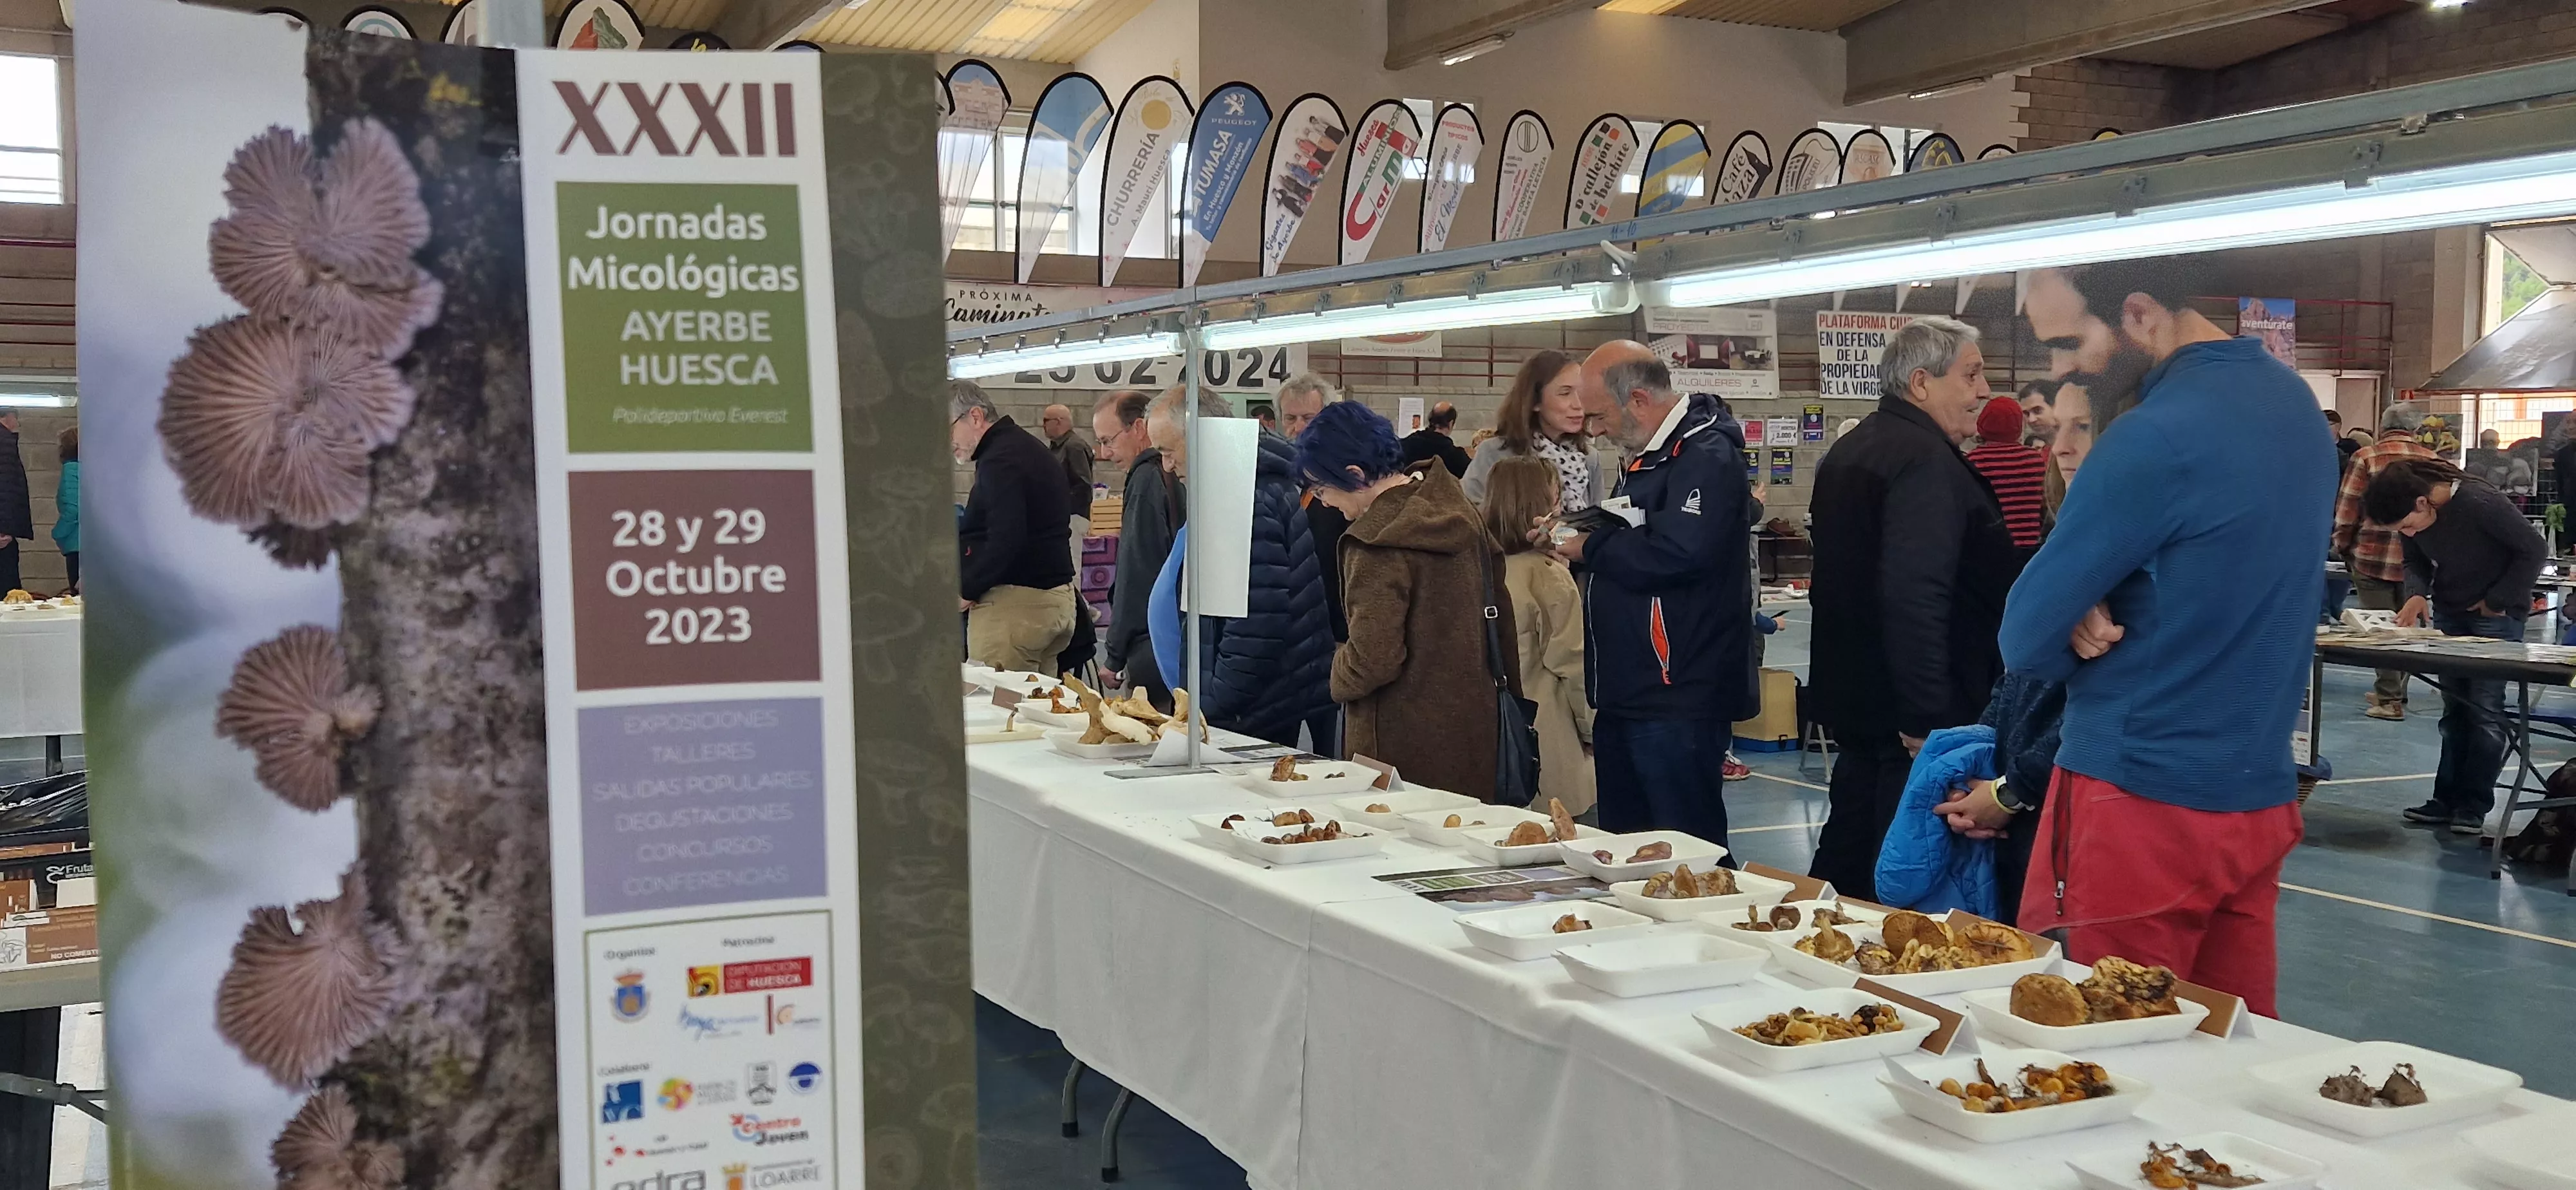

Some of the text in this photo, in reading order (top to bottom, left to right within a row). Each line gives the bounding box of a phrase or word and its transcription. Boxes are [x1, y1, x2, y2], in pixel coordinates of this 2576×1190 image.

[552, 80, 798, 157] XXXII
[1357, 118, 1379, 156] Huesca
[1363, 105, 1404, 185] ALUMINIOS
[1194, 130, 1233, 196] TUMASA
[1208, 180, 1226, 209] Huesca
[1227, 142, 1244, 172] Monzón
[1589, 142, 1630, 211] de belchite
[1721, 153, 1747, 193] Café
[1108, 132, 1160, 227] CHURRERÍA
[1136, 184, 1154, 214] Mauri
[1150, 149, 1171, 184] Huesca
[585, 203, 766, 240] Jornadas
[567, 254, 799, 297] Micológicas
[960, 288, 1033, 303] PRÓXIMA
[621, 311, 772, 342] AYERBE
[1819, 314, 1886, 329] PLATAFORMA
[2240, 317, 2294, 330] aventúrate
[1820, 332, 1886, 348] EN DEFENSA
[1837, 349, 1868, 361] DE LA
[620, 355, 778, 385] HUESCA
[1677, 378, 1742, 388] ALQUILERES
[1821, 381, 1833, 395] DE
[1836, 381, 1850, 395] LA
[613, 406, 789, 424] Polideportivo Everest
[612, 508, 766, 553] 28 y 29
[606, 555, 786, 597] Octubre
[645, 606, 752, 645] 2023
[624, 710, 778, 735] EXPOSICIONES
[651, 743, 755, 764] TALLERES
[592, 771, 813, 801] SALIDAS POPULARES
[616, 804, 793, 831] DEGUSTACIONES
[638, 838, 773, 863] CONCURSOS
[623, 867, 789, 896] CONFERENCIAS
